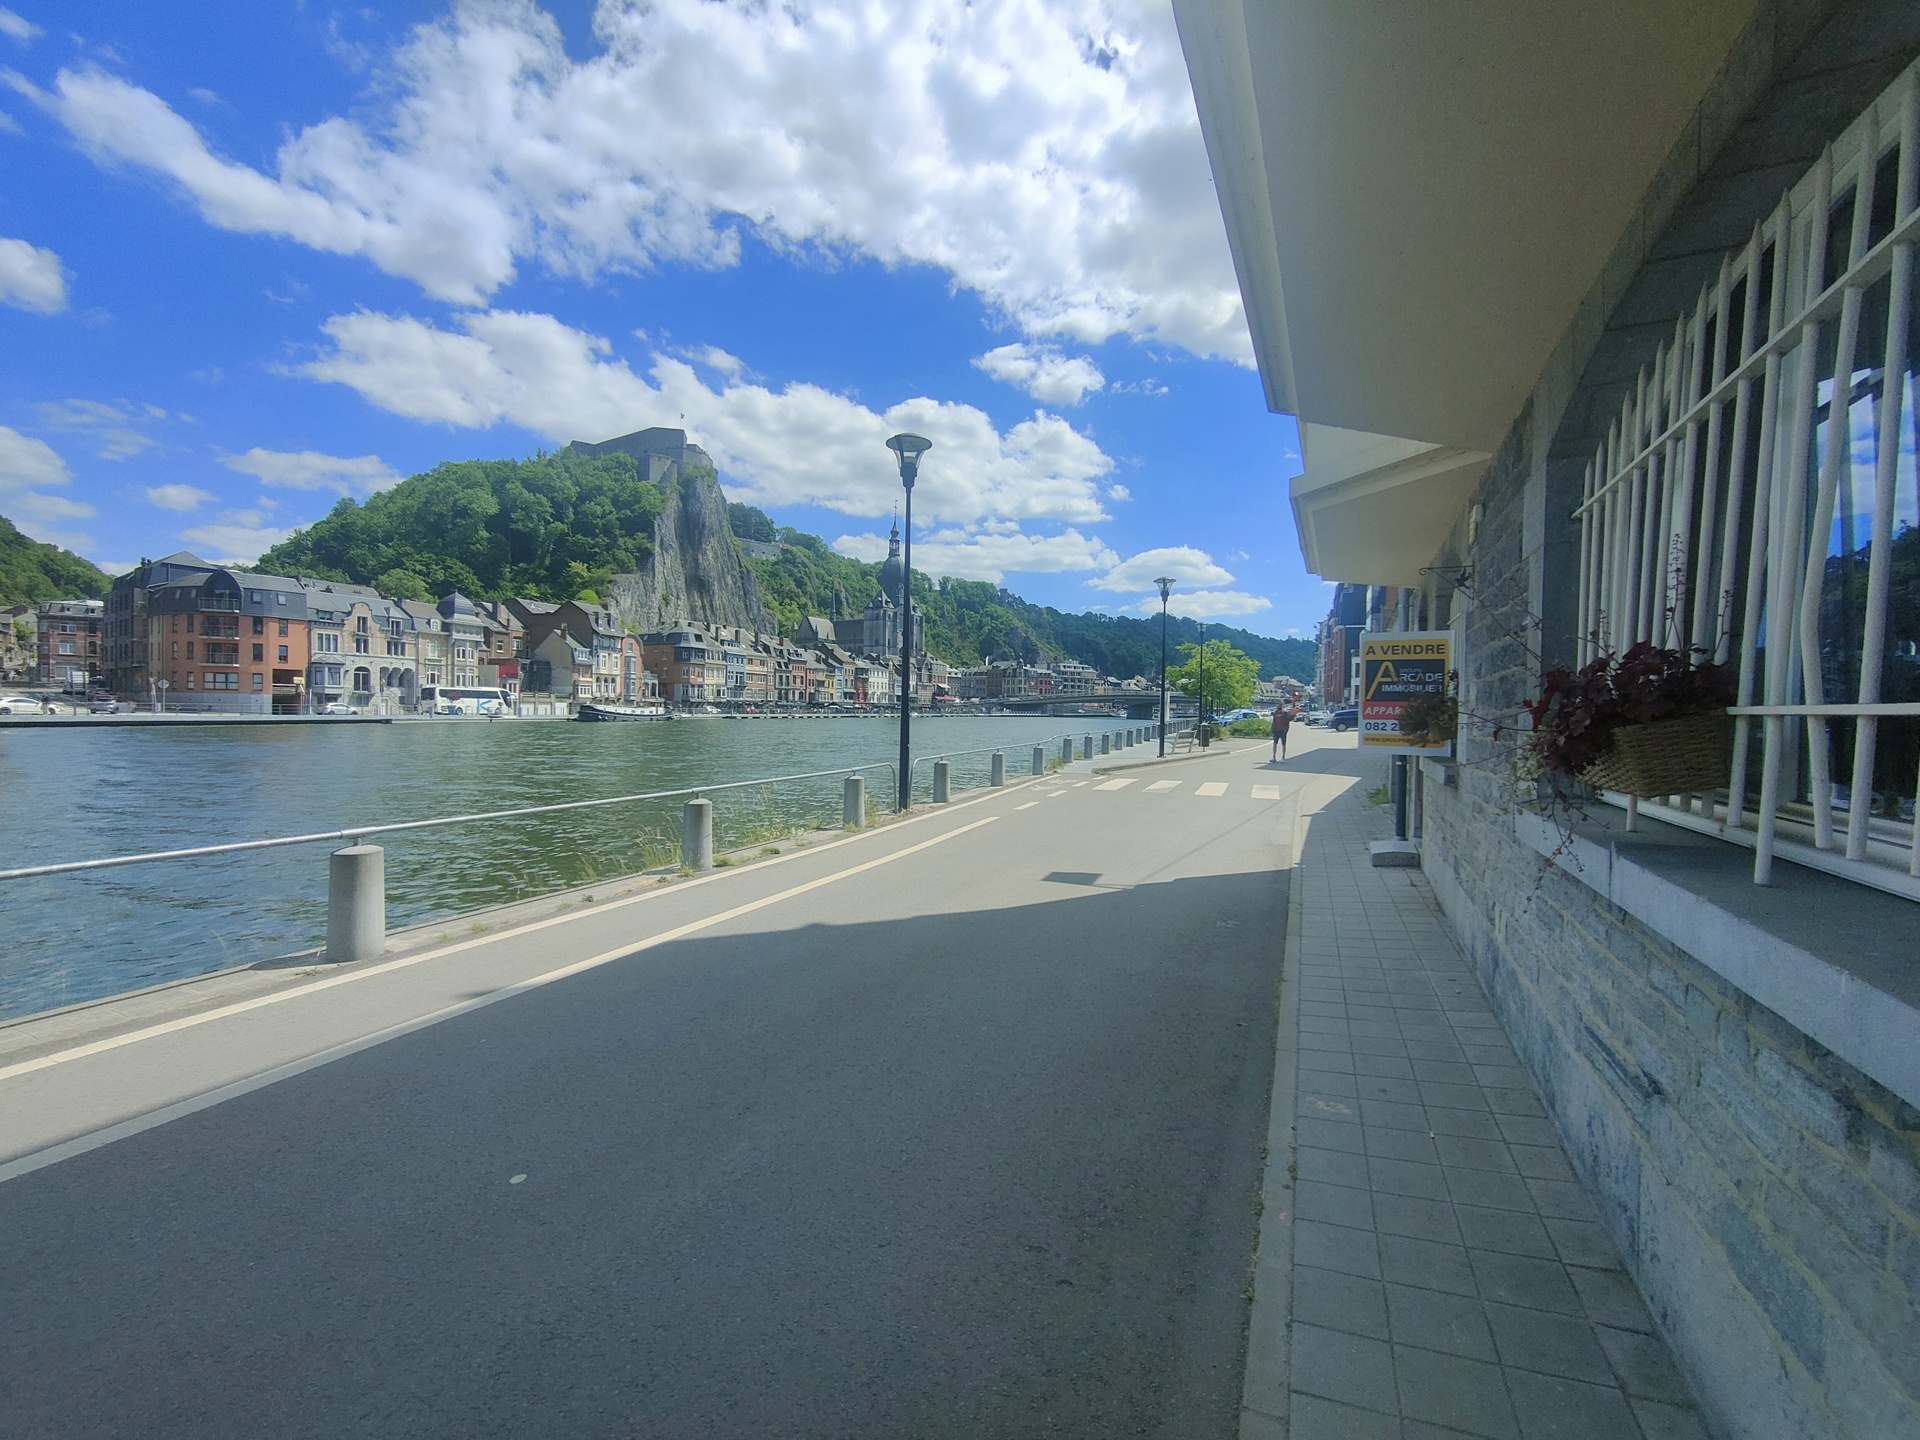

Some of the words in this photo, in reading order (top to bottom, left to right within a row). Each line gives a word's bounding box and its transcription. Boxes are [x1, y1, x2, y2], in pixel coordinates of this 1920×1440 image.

[1366, 646, 1376, 655] A
[1380, 644, 1445, 655] VENDRE
[1364, 706, 1402, 715] APPAR
[1364, 722, 1387, 731] 082
[1390, 722, 1398, 731] 2
